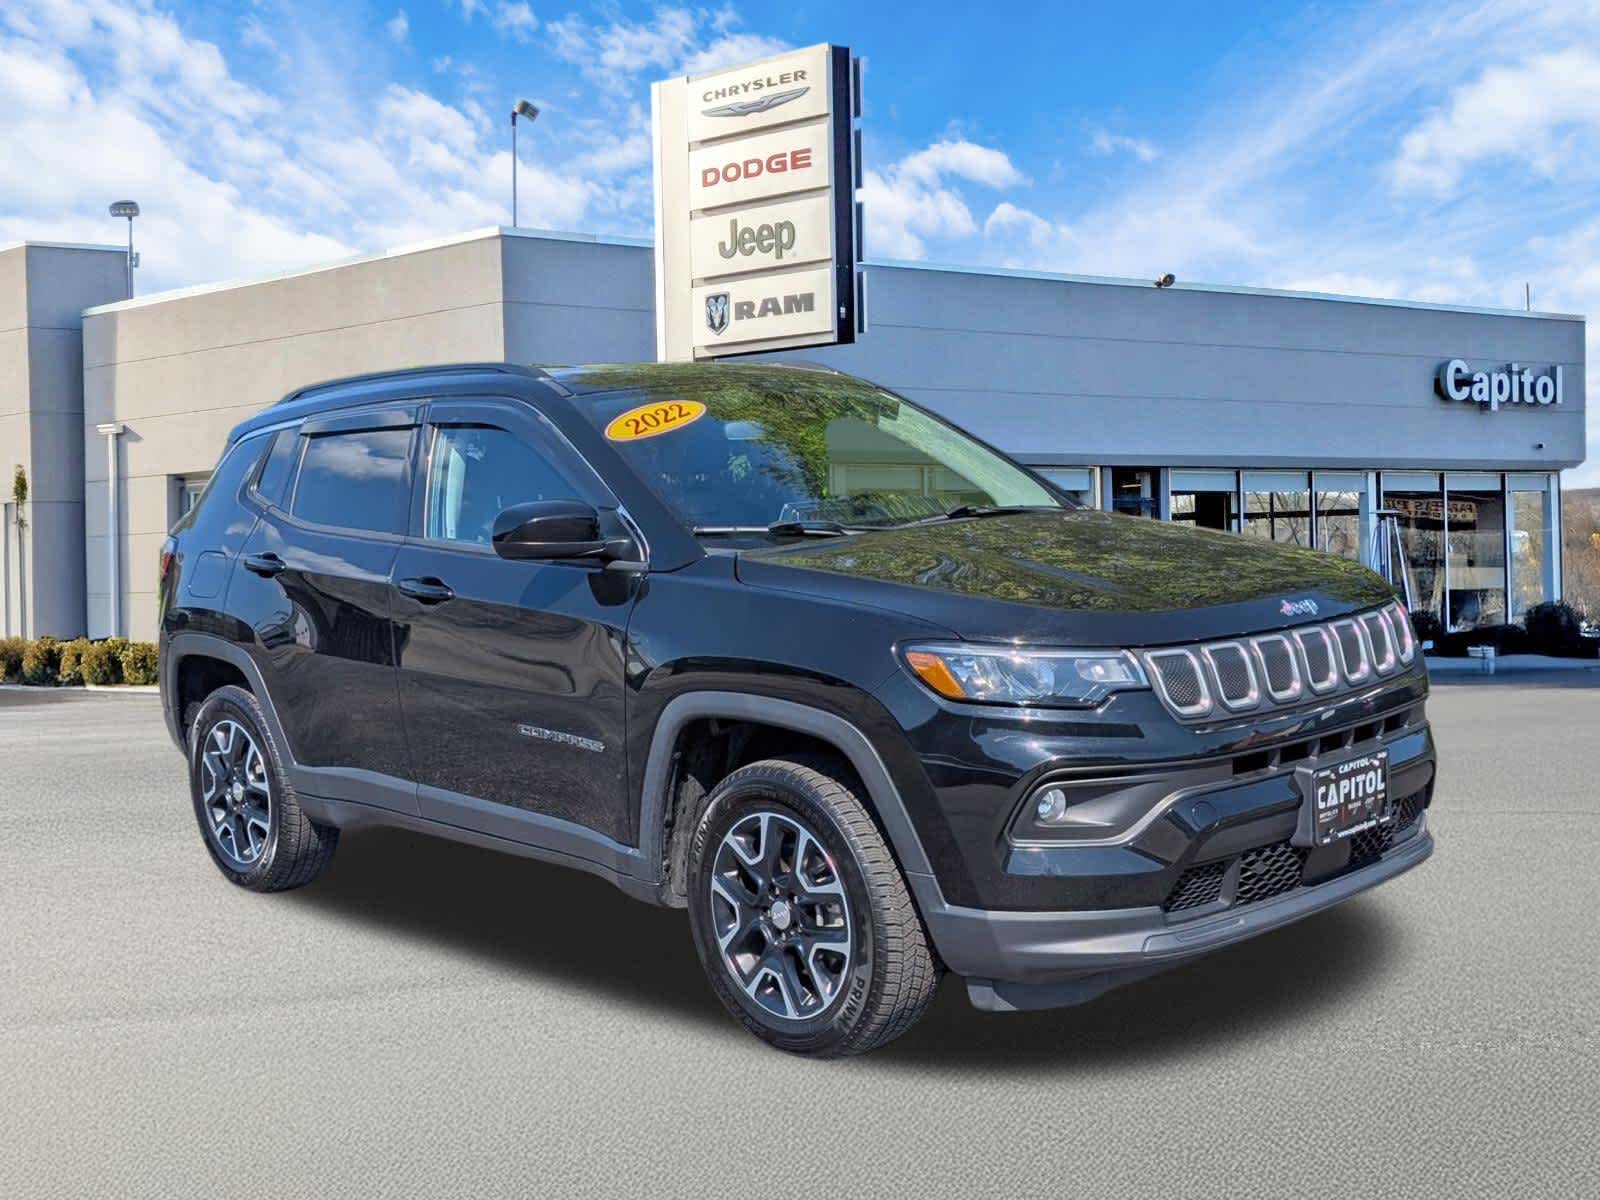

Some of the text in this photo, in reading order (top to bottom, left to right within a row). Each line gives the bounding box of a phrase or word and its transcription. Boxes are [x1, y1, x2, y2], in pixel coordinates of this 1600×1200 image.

[702, 70, 808, 102] CHRYSLER
[702, 148, 812, 187] DODGE
[718, 218, 795, 259] Jeep
[734, 292, 815, 320] RAM
[1445, 359, 1563, 411] Capitol
[624, 404, 691, 435] 2022
[1338, 758, 1371, 774] CAPITOL
[1318, 768, 1385, 809] CAPITOL
